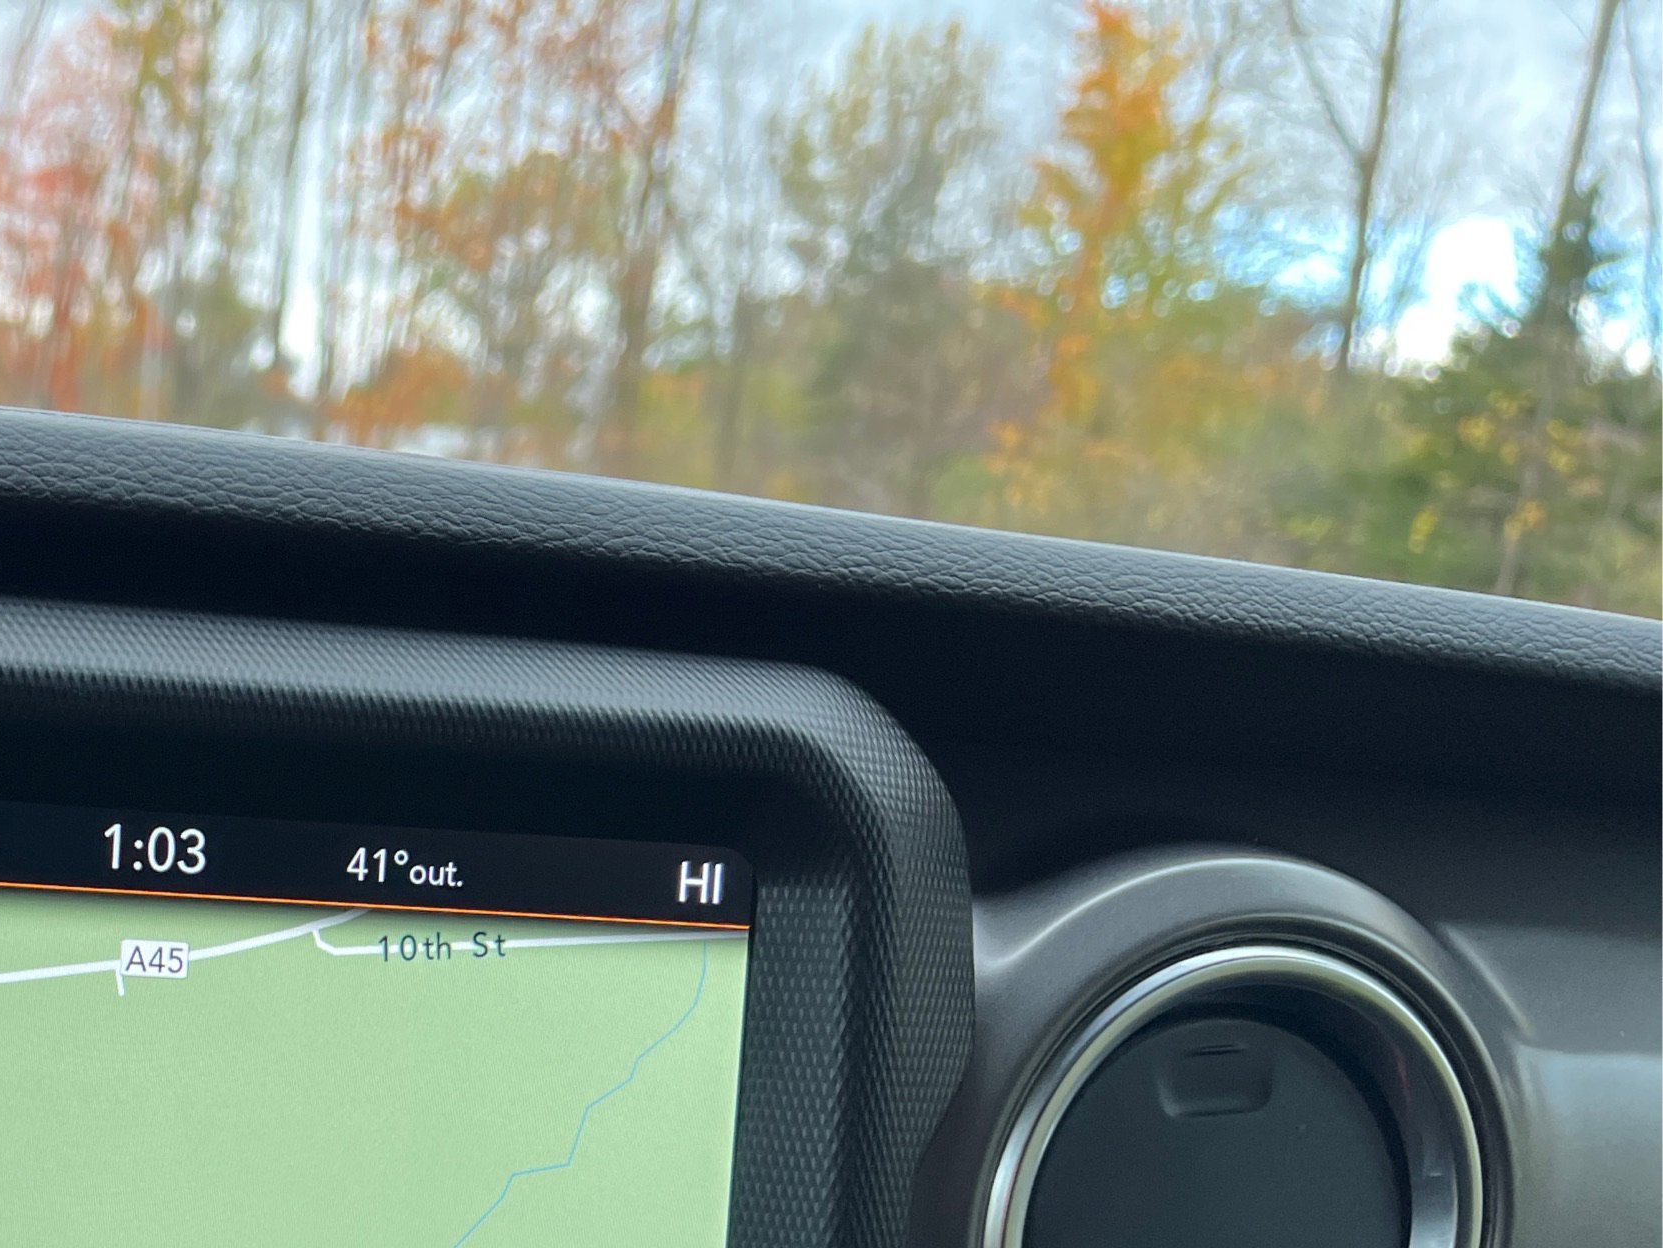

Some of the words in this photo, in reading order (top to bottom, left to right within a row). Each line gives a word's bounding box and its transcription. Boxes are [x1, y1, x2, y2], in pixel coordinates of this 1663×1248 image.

[102, 822, 208, 875] 1:03
[678, 859, 725, 905] HI
[124, 945, 185, 975] A45
[376, 933, 453, 963] 10th
[472, 931, 508, 959] St
